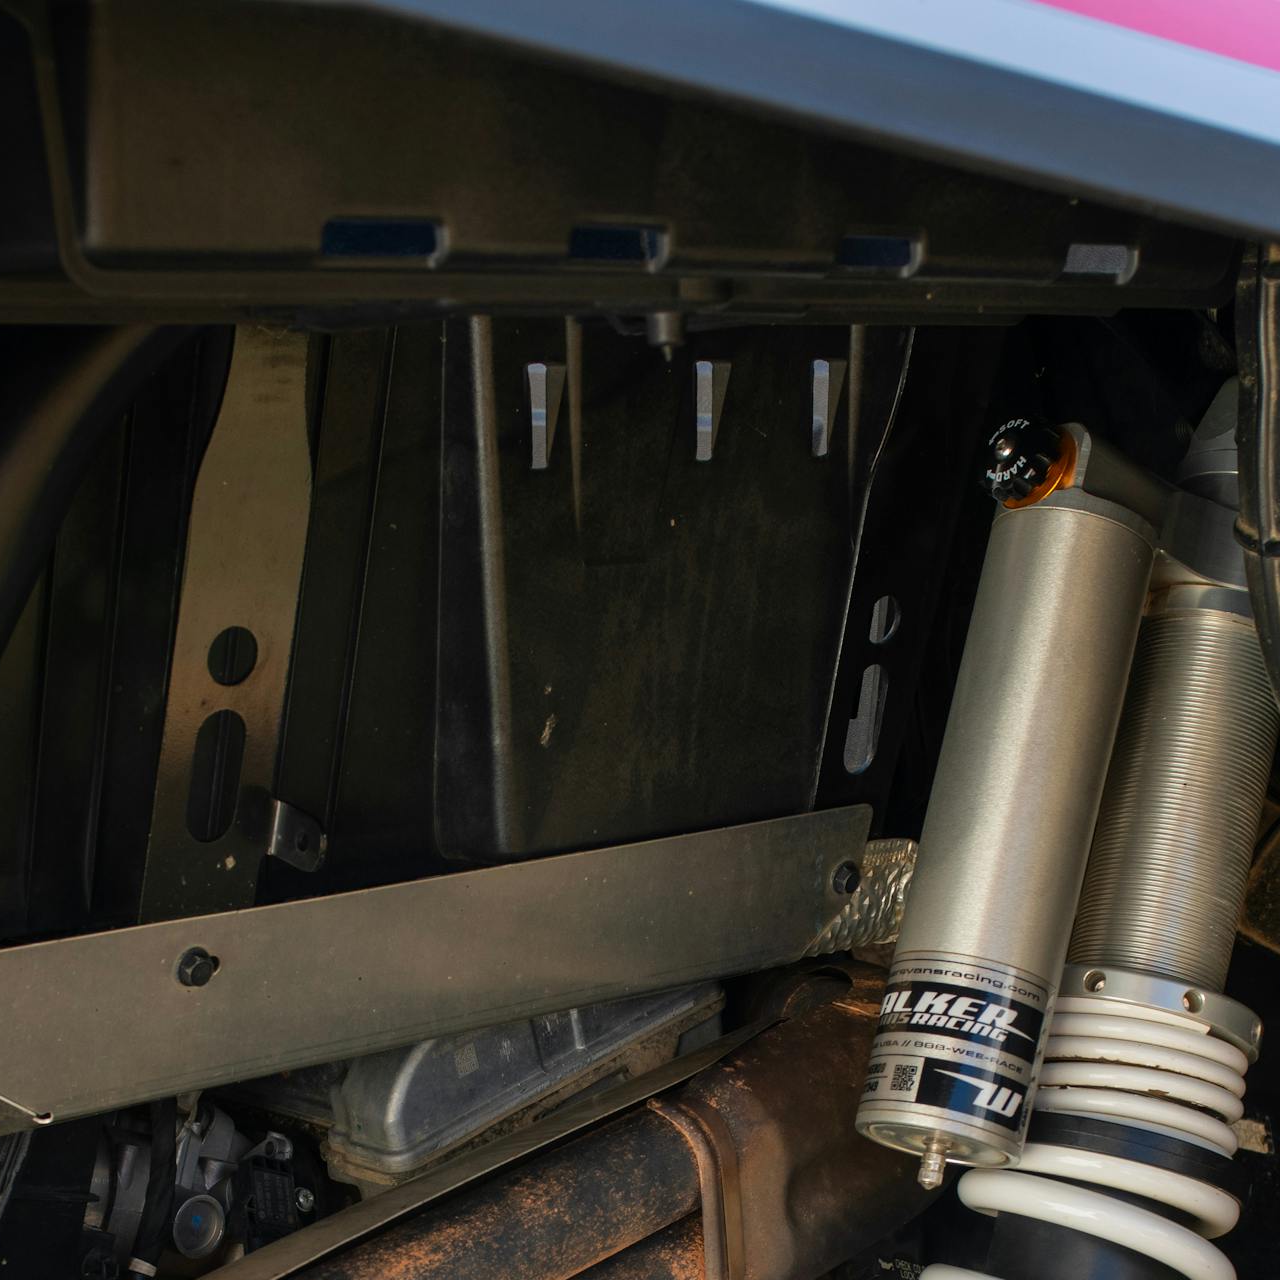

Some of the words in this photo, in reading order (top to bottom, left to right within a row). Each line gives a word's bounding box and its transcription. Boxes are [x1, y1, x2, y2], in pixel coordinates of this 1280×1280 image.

[999, 418, 1030, 433] SOFT
[996, 456, 1027, 482] HARD
[910, 1012, 1009, 1042] RACING
